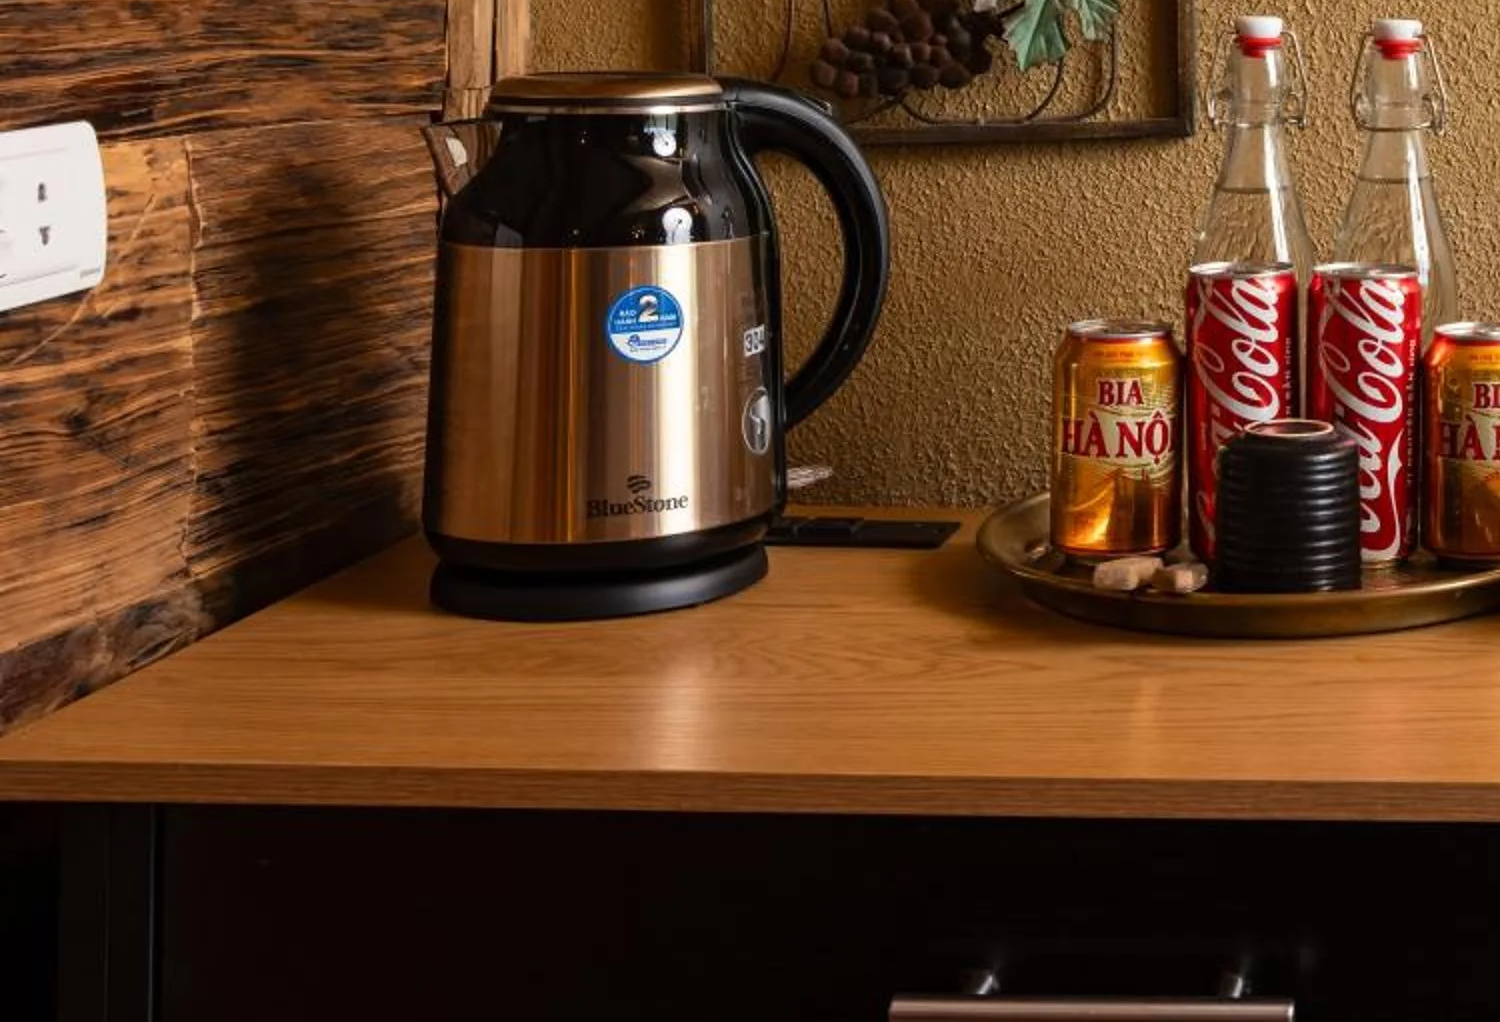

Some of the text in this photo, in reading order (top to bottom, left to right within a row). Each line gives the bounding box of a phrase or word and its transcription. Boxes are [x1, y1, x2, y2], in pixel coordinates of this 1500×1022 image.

[637, 294, 659, 323] 2
[1098, 379, 1144, 406] BIA
[1062, 408, 1110, 458] HÀ
[1438, 413, 1486, 461] HÀ
[586, 495, 689, 519] BlueStone
